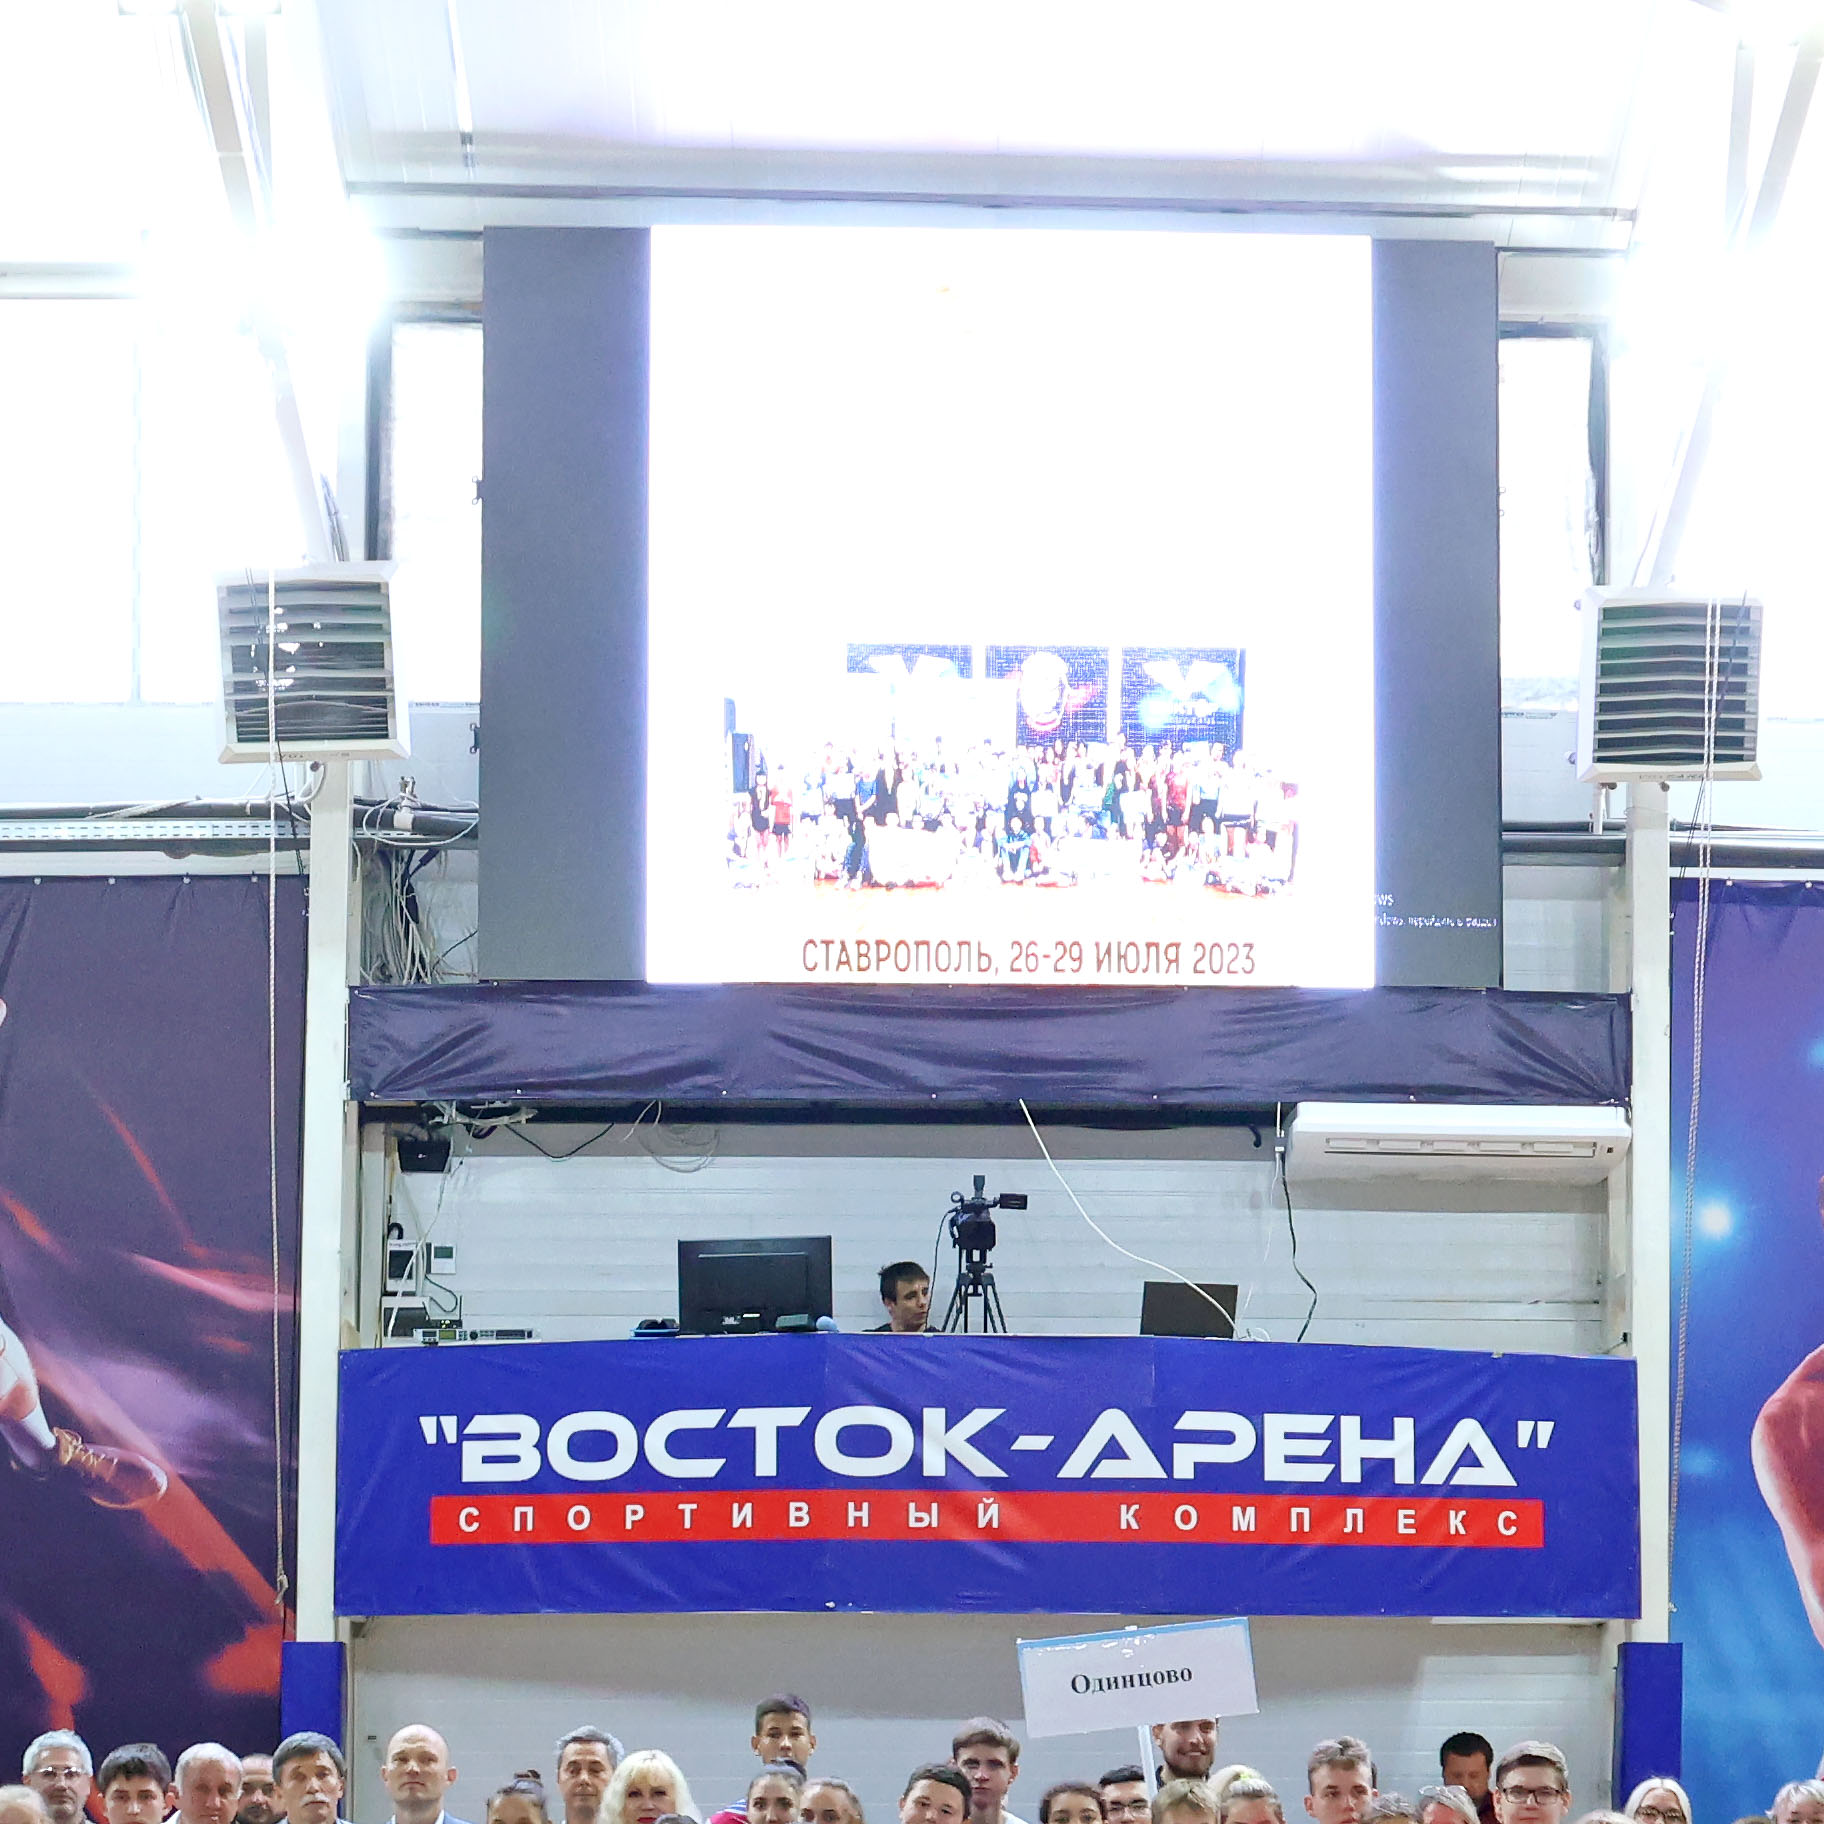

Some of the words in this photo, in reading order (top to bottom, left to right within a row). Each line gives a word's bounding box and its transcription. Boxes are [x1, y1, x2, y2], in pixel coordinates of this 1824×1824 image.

[802, 938, 999, 976] СТАВРОПОЛЬ,
[1010, 940, 1084, 974] 26-29
[1095, 941, 1181, 974] ИЮЛЯ
[1193, 942, 1256, 975] 2023
[458, 1497, 1003, 1534] СПОРТИВНЫЙ
[1118, 1503, 1520, 1538] КОМПЛЕКС
[1070, 1666, 1193, 1695] Одинцово
